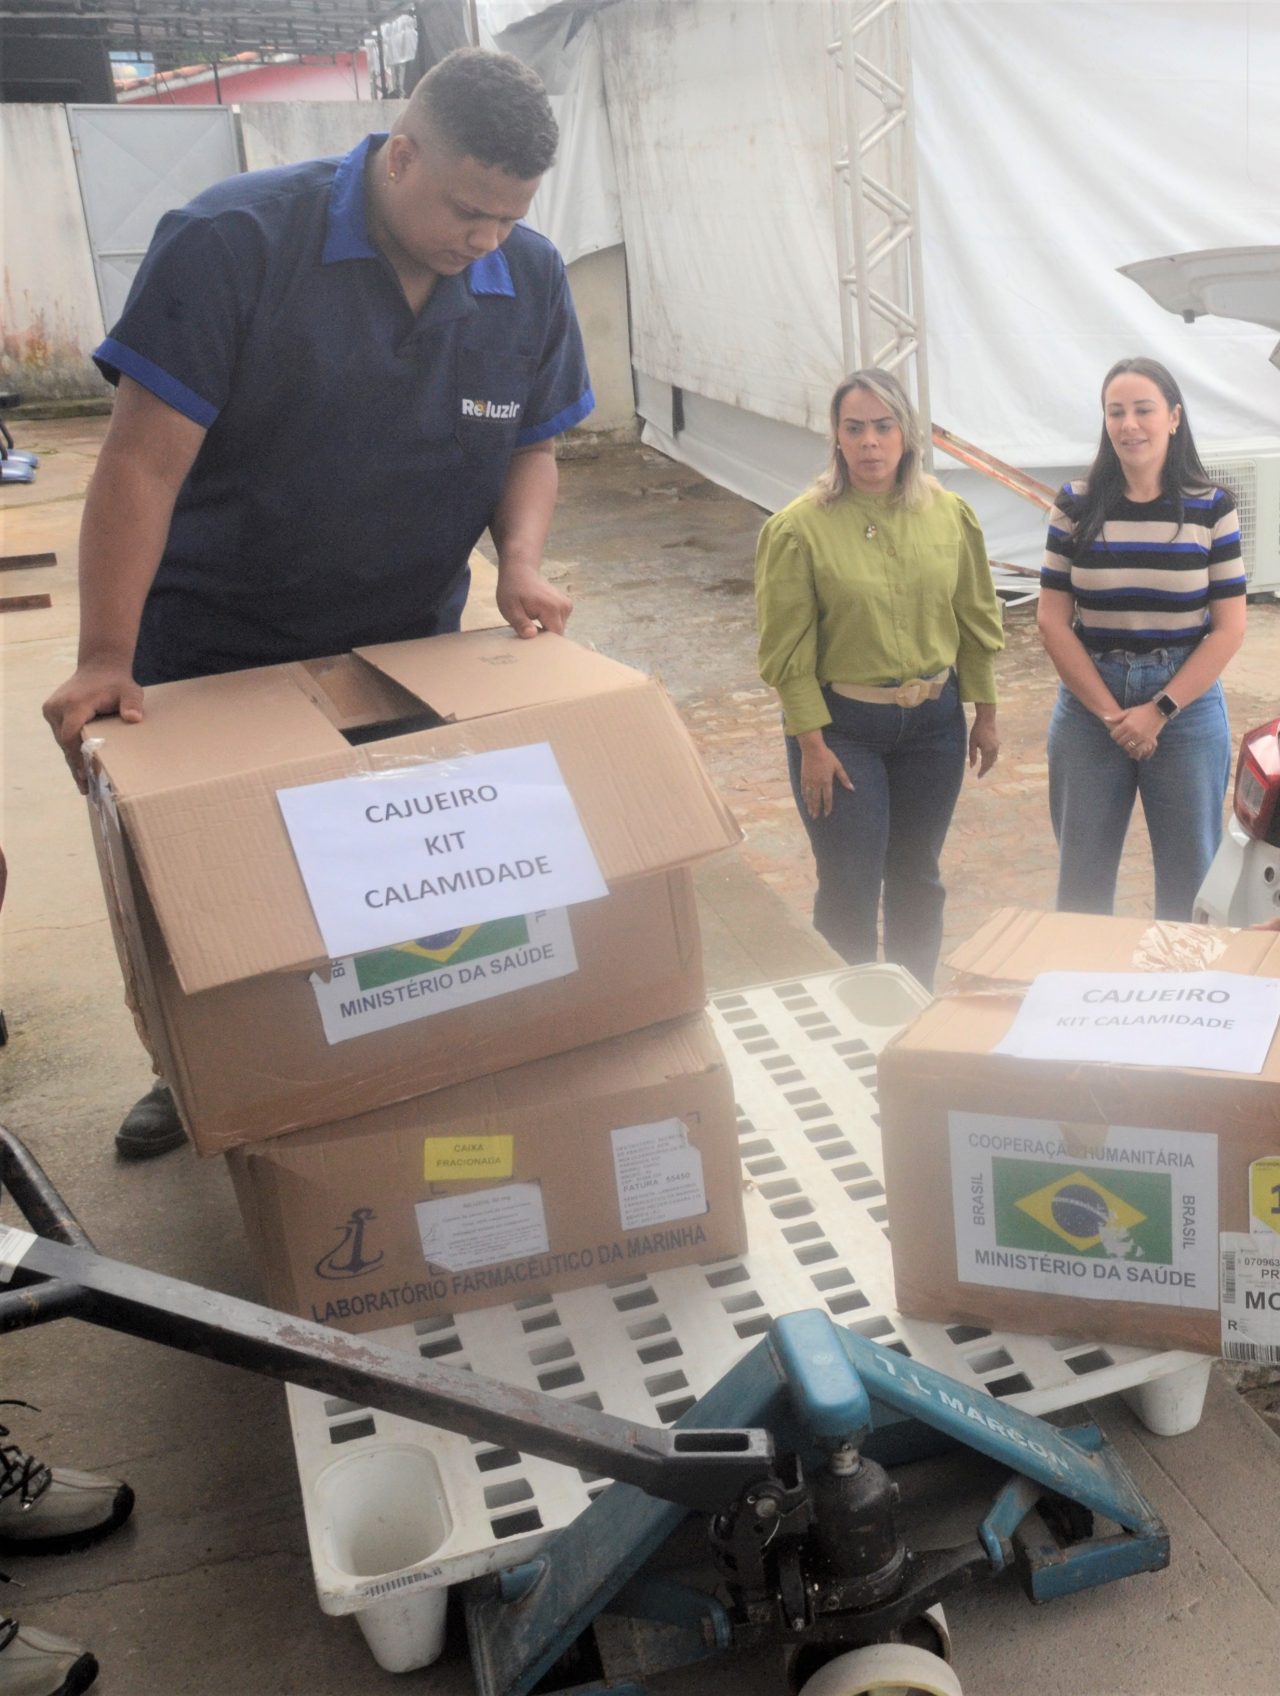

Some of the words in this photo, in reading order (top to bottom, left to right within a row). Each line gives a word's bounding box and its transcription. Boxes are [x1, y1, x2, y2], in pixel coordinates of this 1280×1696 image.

[462, 399, 520, 418] Reluzir
[365, 784, 498, 823] CAJUEIRO
[424, 830, 466, 856] KIT
[364, 855, 552, 909] CALAMIDADE
[340, 973, 454, 1018] MINISTÉRIO
[458, 964, 486, 985] DA
[490, 944, 555, 975] SAÚDE
[1082, 988, 1231, 1004] CAJUEIRO
[1056, 1015, 1090, 1027] KIT
[1094, 1014, 1236, 1030] CALAMIDADE
[454, 1143, 484, 1153] CAIXA
[1083, 1144, 1195, 1168] HUMANITÁRIA
[436, 1156, 502, 1168] FRACIONADA
[623, 1178, 659, 1193] FATURA
[971, 1172, 986, 1226] BRASIL
[1182, 1194, 1196, 1250] BRASIL
[311, 1280, 447, 1324] LABORATÓRIO
[452, 1248, 593, 1296] FARMACÊUTICO
[598, 1242, 624, 1264] DA
[627, 1223, 706, 1258] MARINHA
[975, 1249, 1087, 1277] MINISTÉRIO
[1093, 1263, 1121, 1281] DA
[1126, 1266, 1196, 1289] SAÚDE
[1227, 1319, 1238, 1331] R
